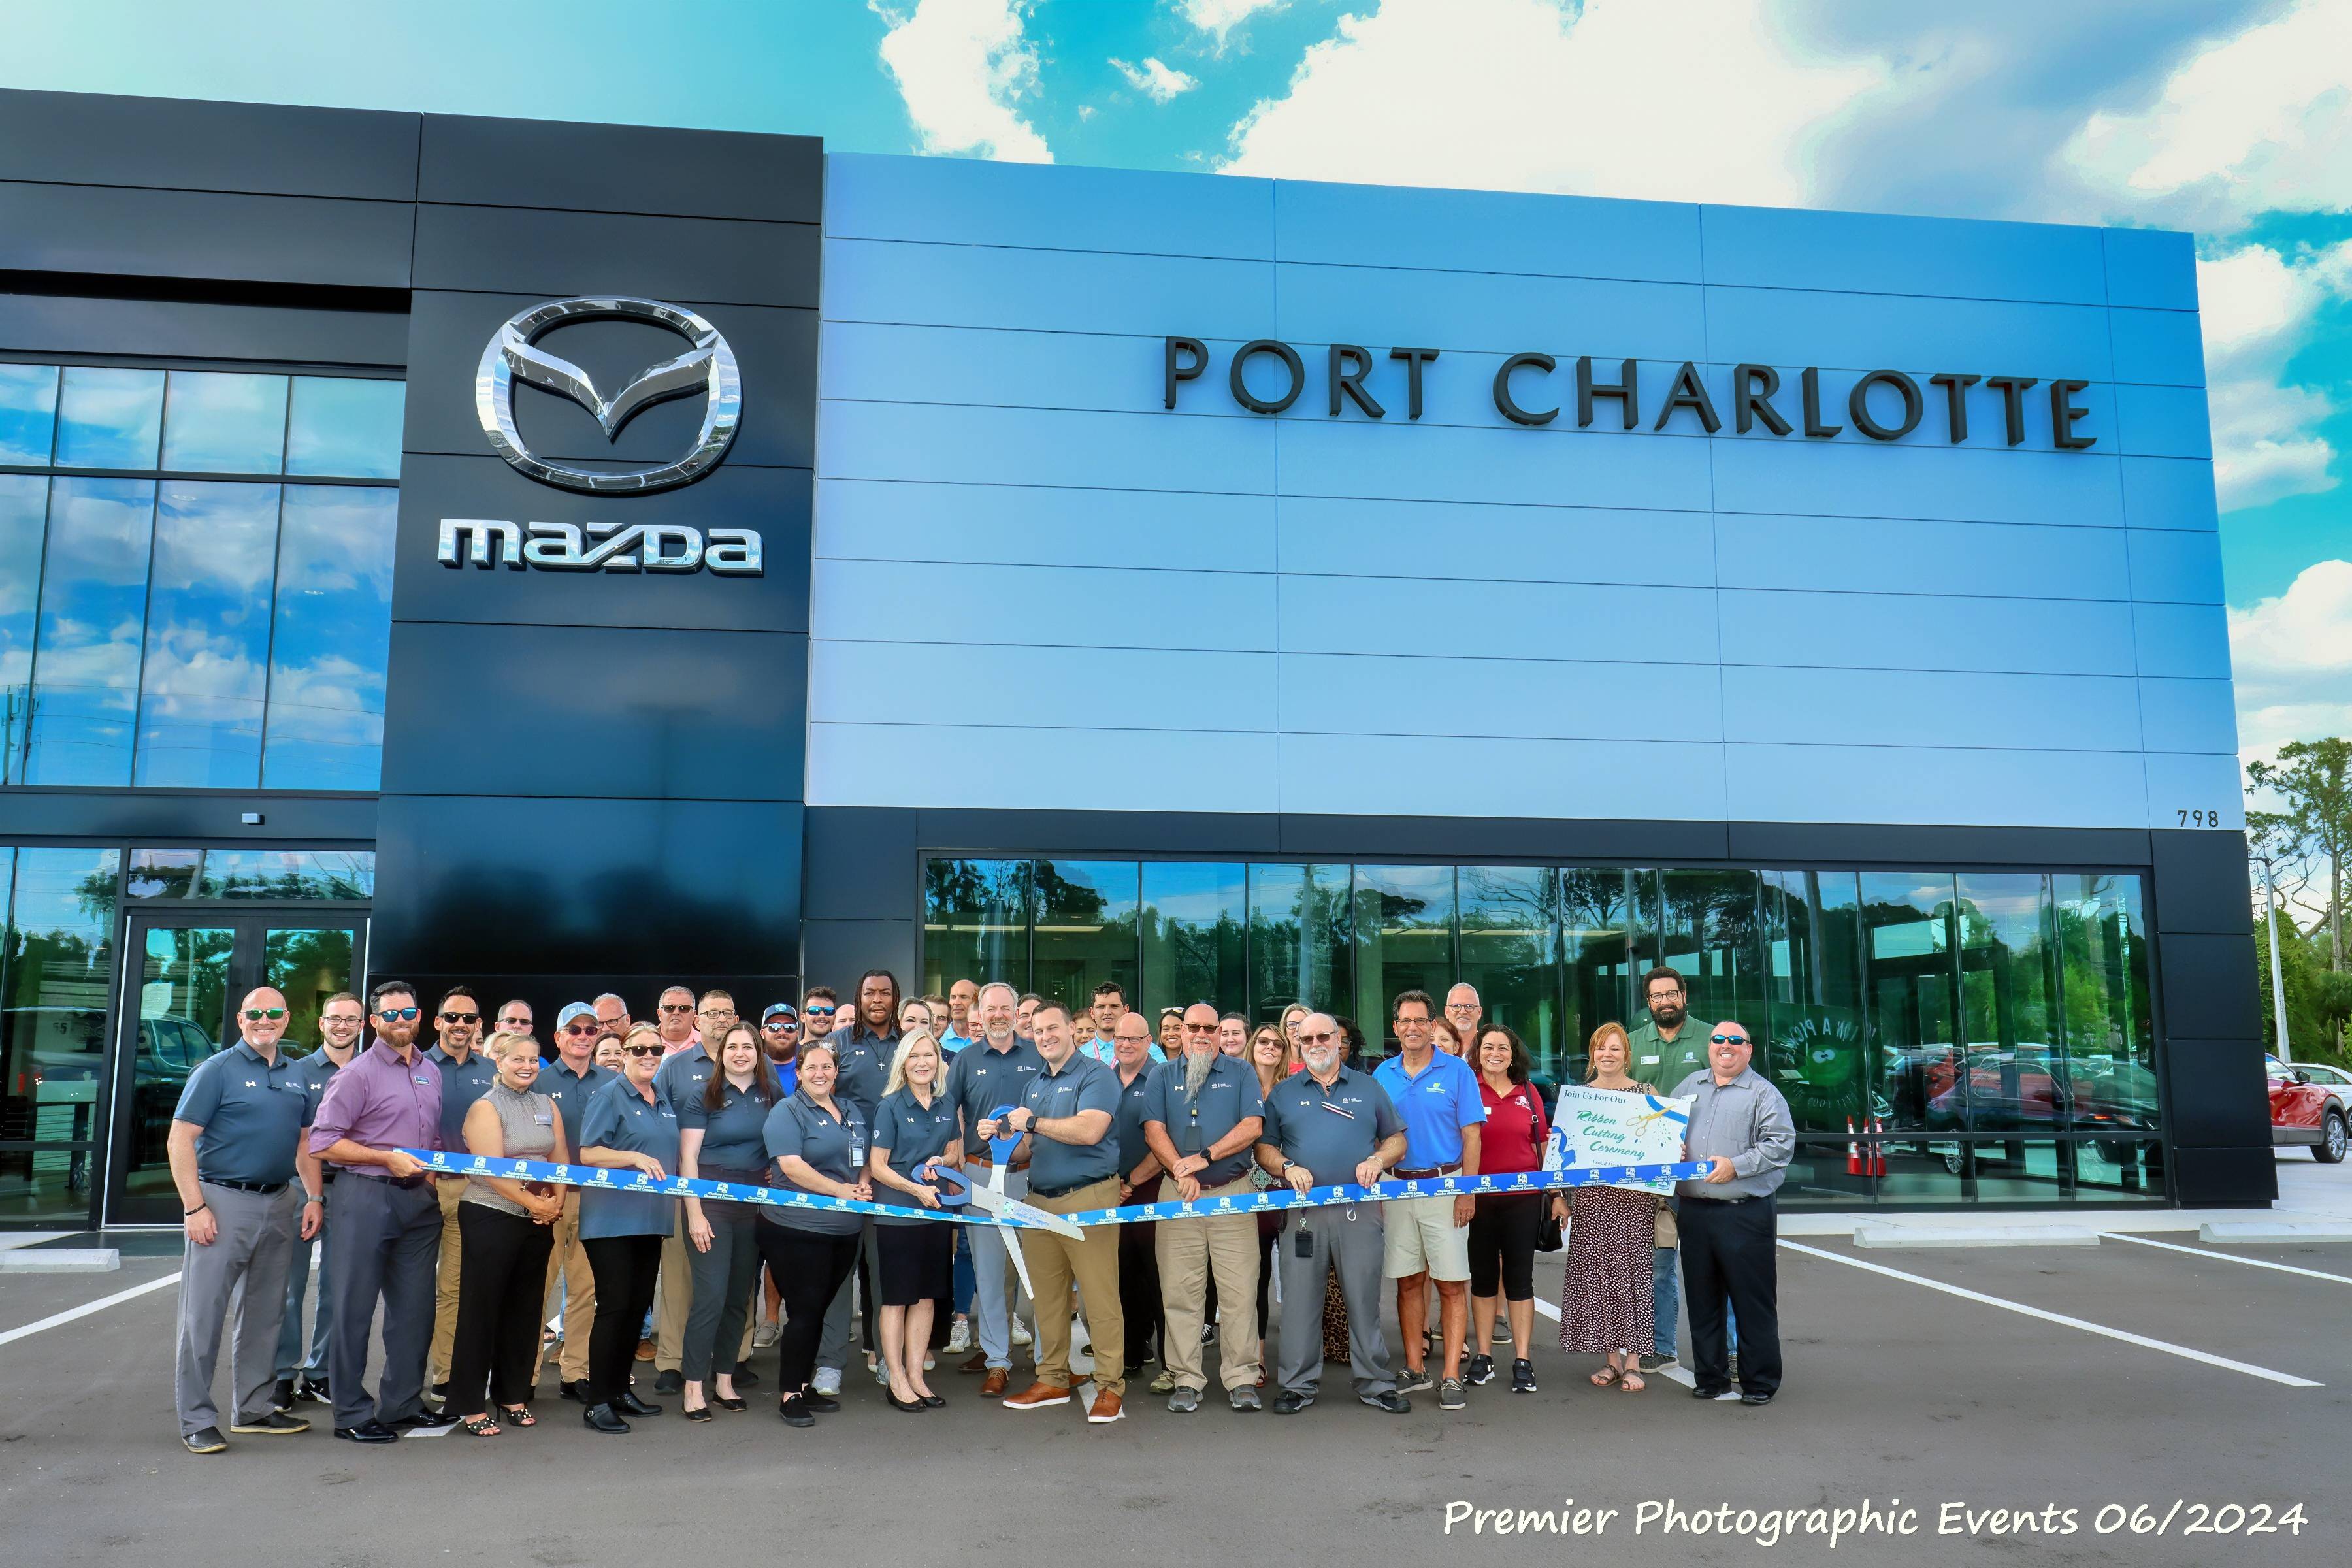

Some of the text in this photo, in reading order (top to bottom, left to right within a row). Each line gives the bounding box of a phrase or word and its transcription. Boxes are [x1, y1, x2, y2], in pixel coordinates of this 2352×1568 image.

[1166, 335, 2097, 449] PORT CHARLOTTE
[2177, 809, 2219, 828] 798
[1564, 1090, 1580, 1098] Join
[1594, 1093, 1609, 1102] For
[1610, 1095, 1627, 1104] Our
[1576, 1110, 1618, 1125] Ribbon
[1582, 1126, 1627, 1144] Cutting
[1589, 1141, 1646, 1161] Ceremony
